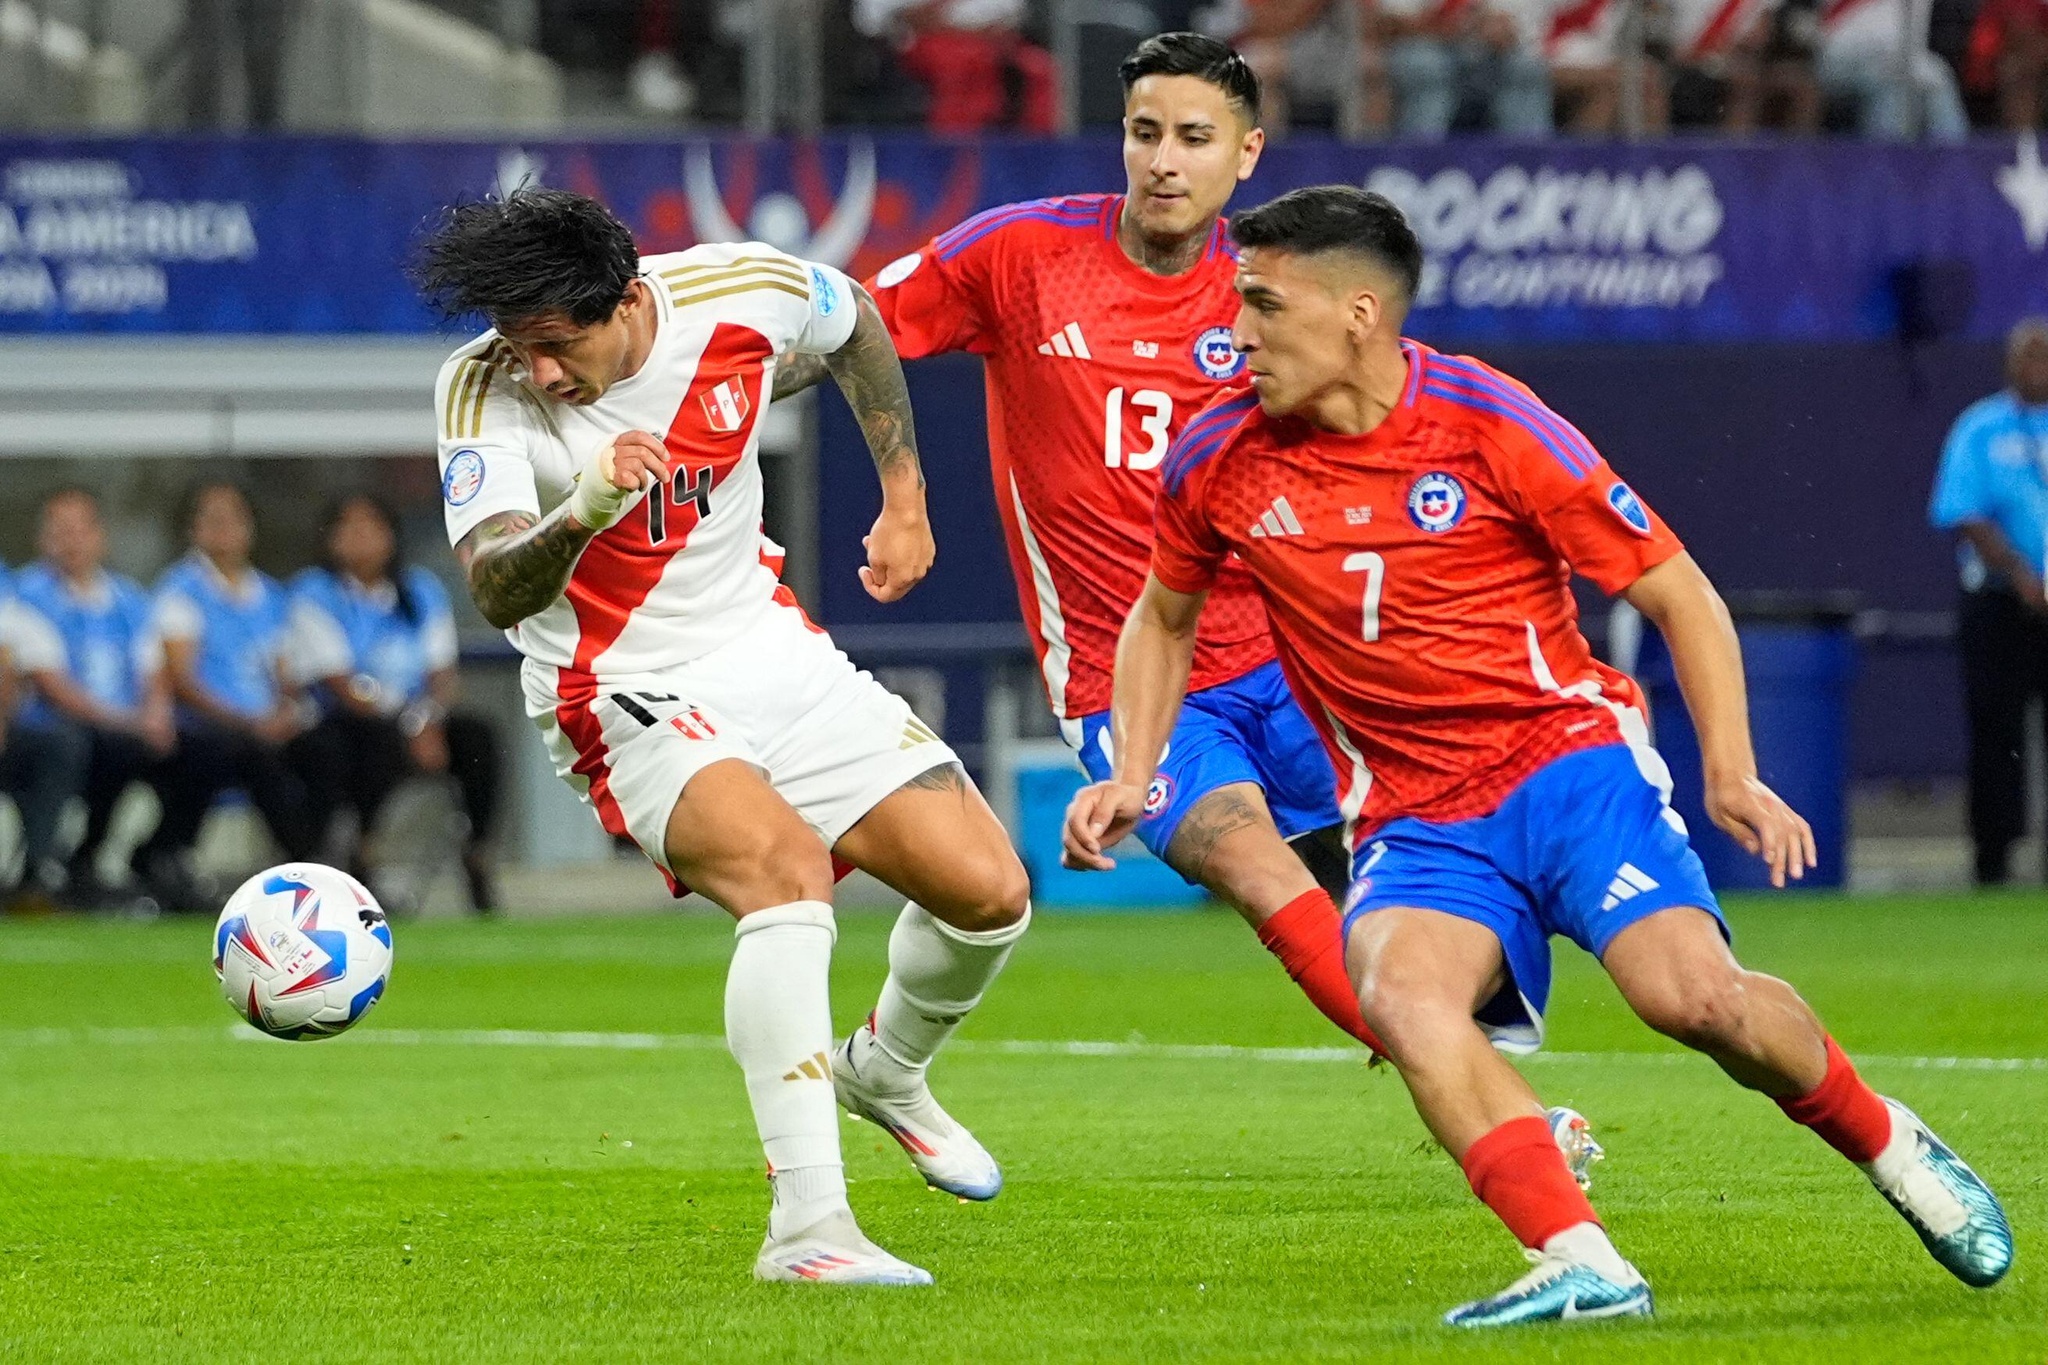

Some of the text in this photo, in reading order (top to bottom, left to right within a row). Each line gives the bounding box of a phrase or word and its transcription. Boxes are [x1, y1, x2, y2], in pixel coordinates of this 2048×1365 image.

[1365, 164, 1722, 253] ROCKING
[1452, 252, 1722, 307] CONTINENT
[1104, 387, 1173, 470] 13
[647, 463, 713, 547] 14
[1342, 551, 1385, 642] 7
[1359, 840, 1388, 877] 7
